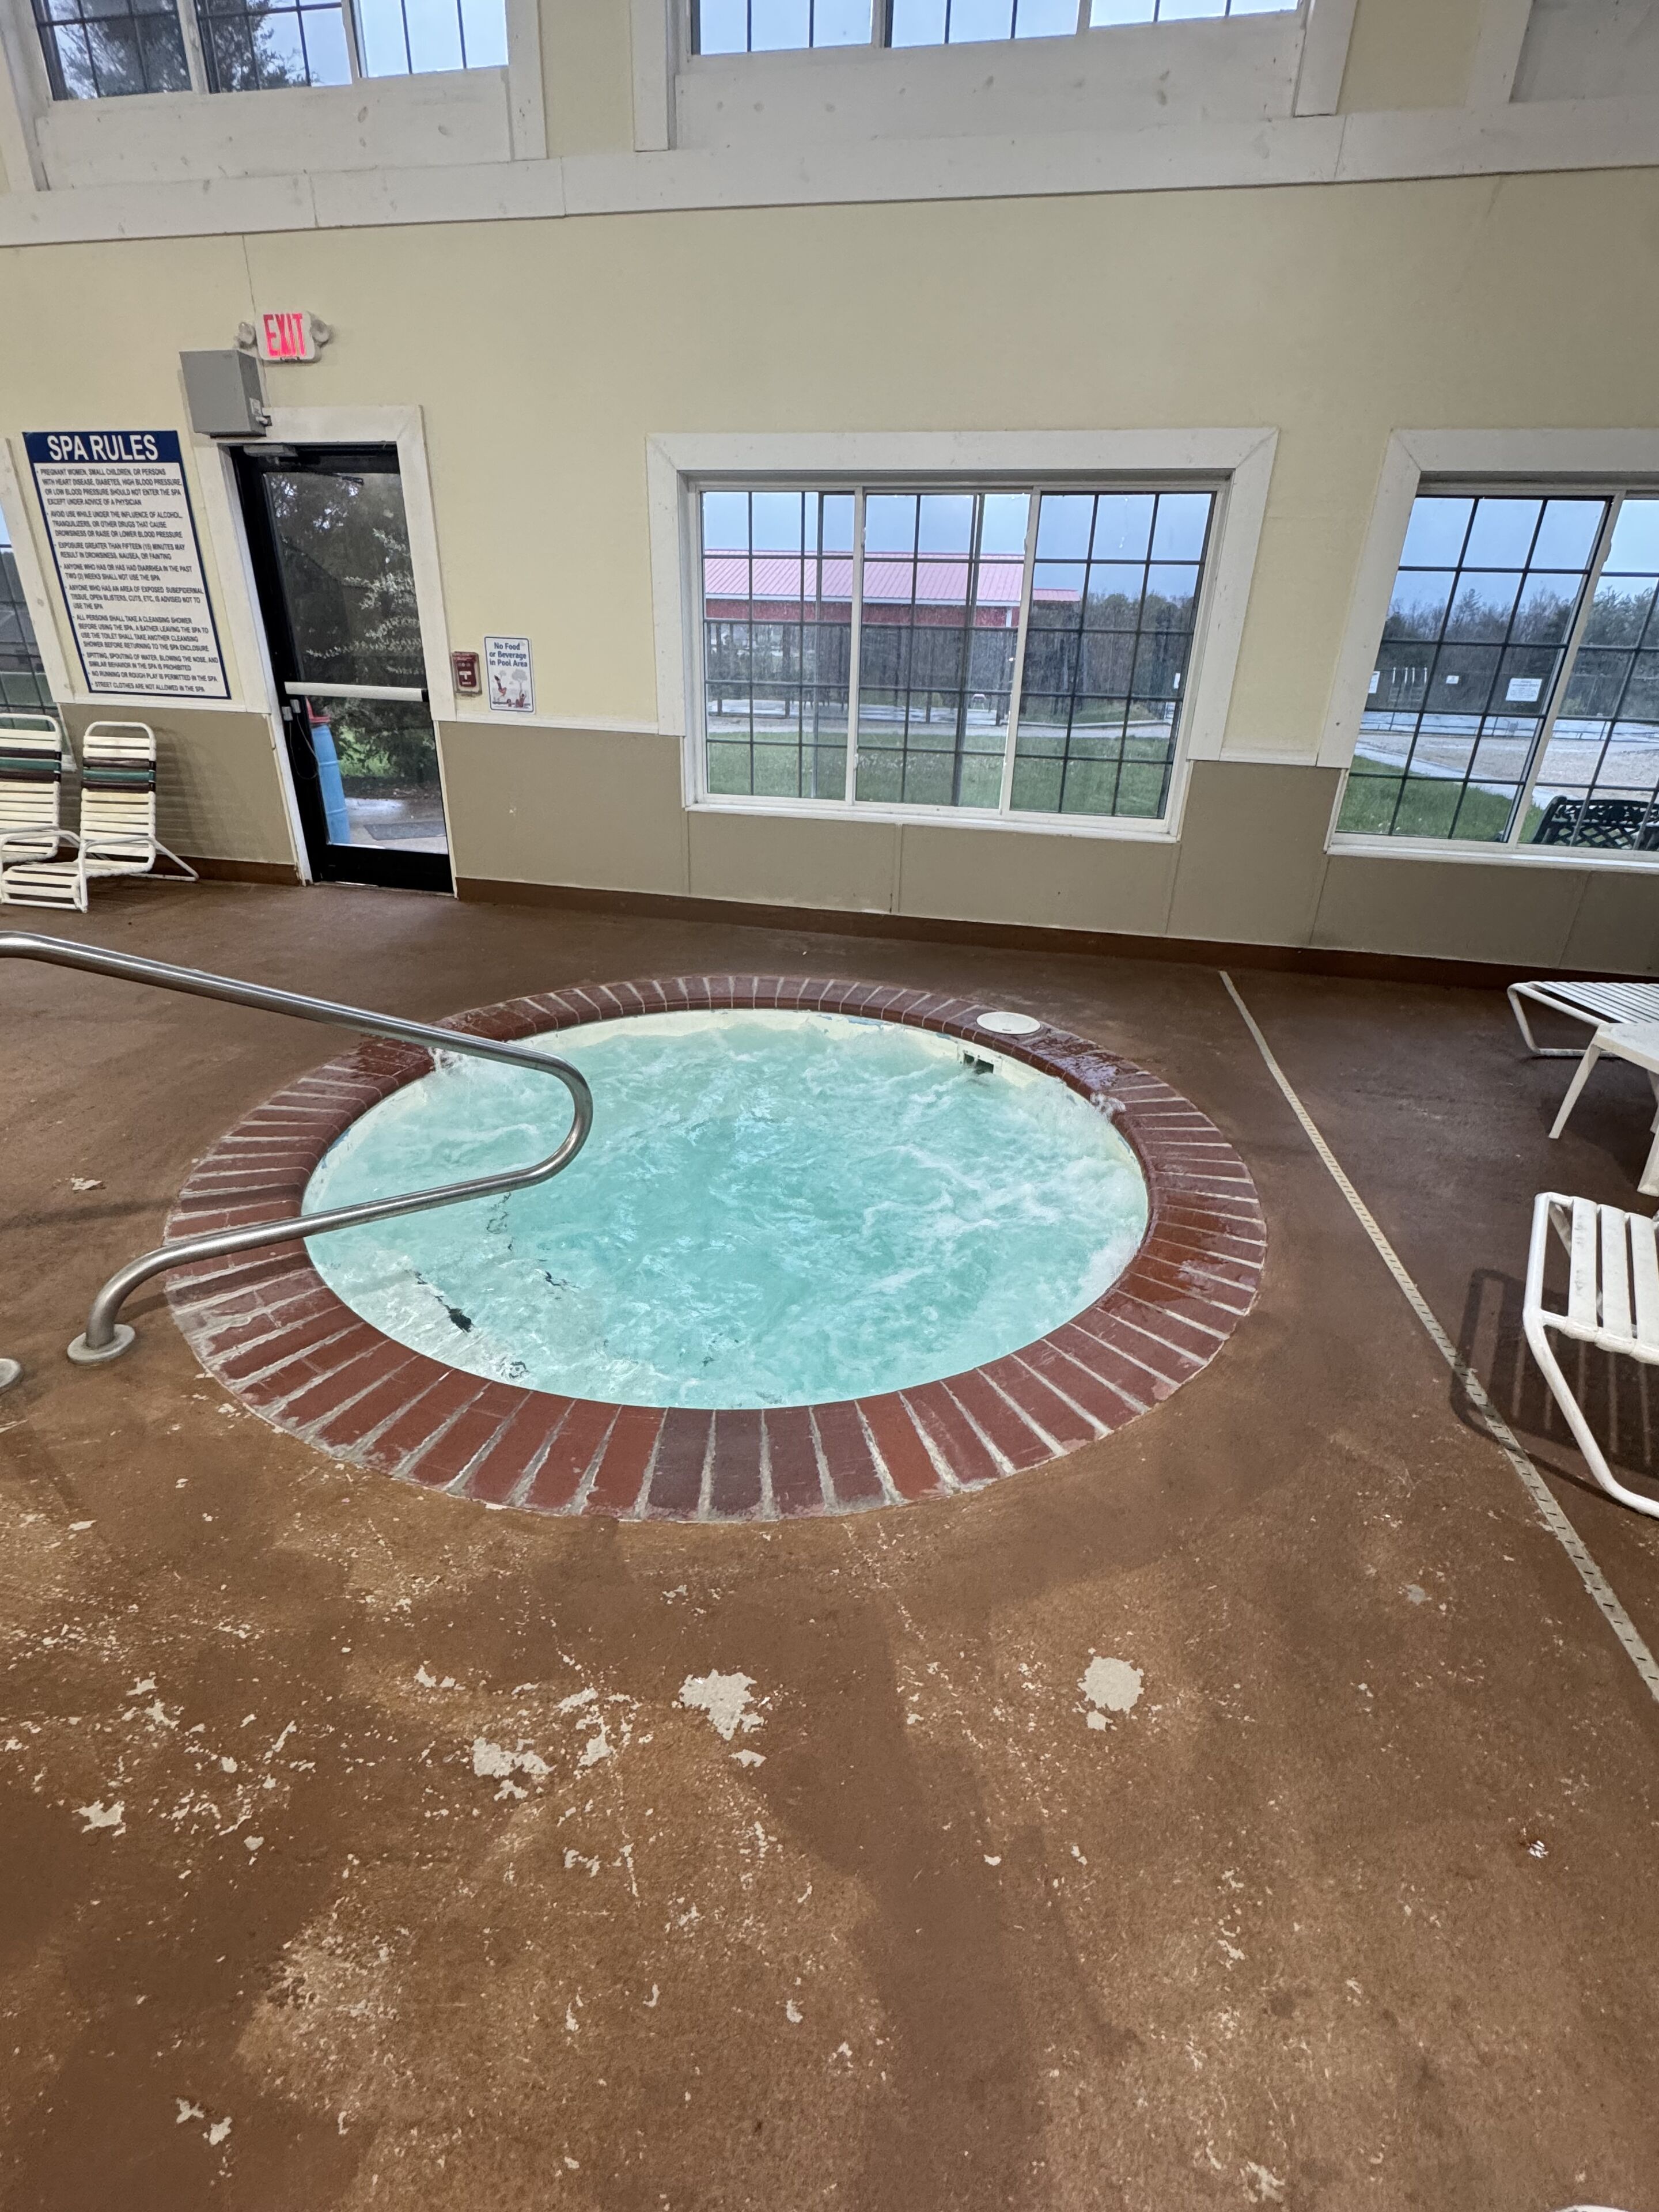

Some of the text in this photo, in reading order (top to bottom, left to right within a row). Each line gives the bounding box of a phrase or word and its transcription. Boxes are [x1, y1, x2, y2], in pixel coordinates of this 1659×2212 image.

[263, 313, 305, 357] EXIT
[47, 434, 158, 461] SPA RULES
[498, 651, 527, 661] Beverage
